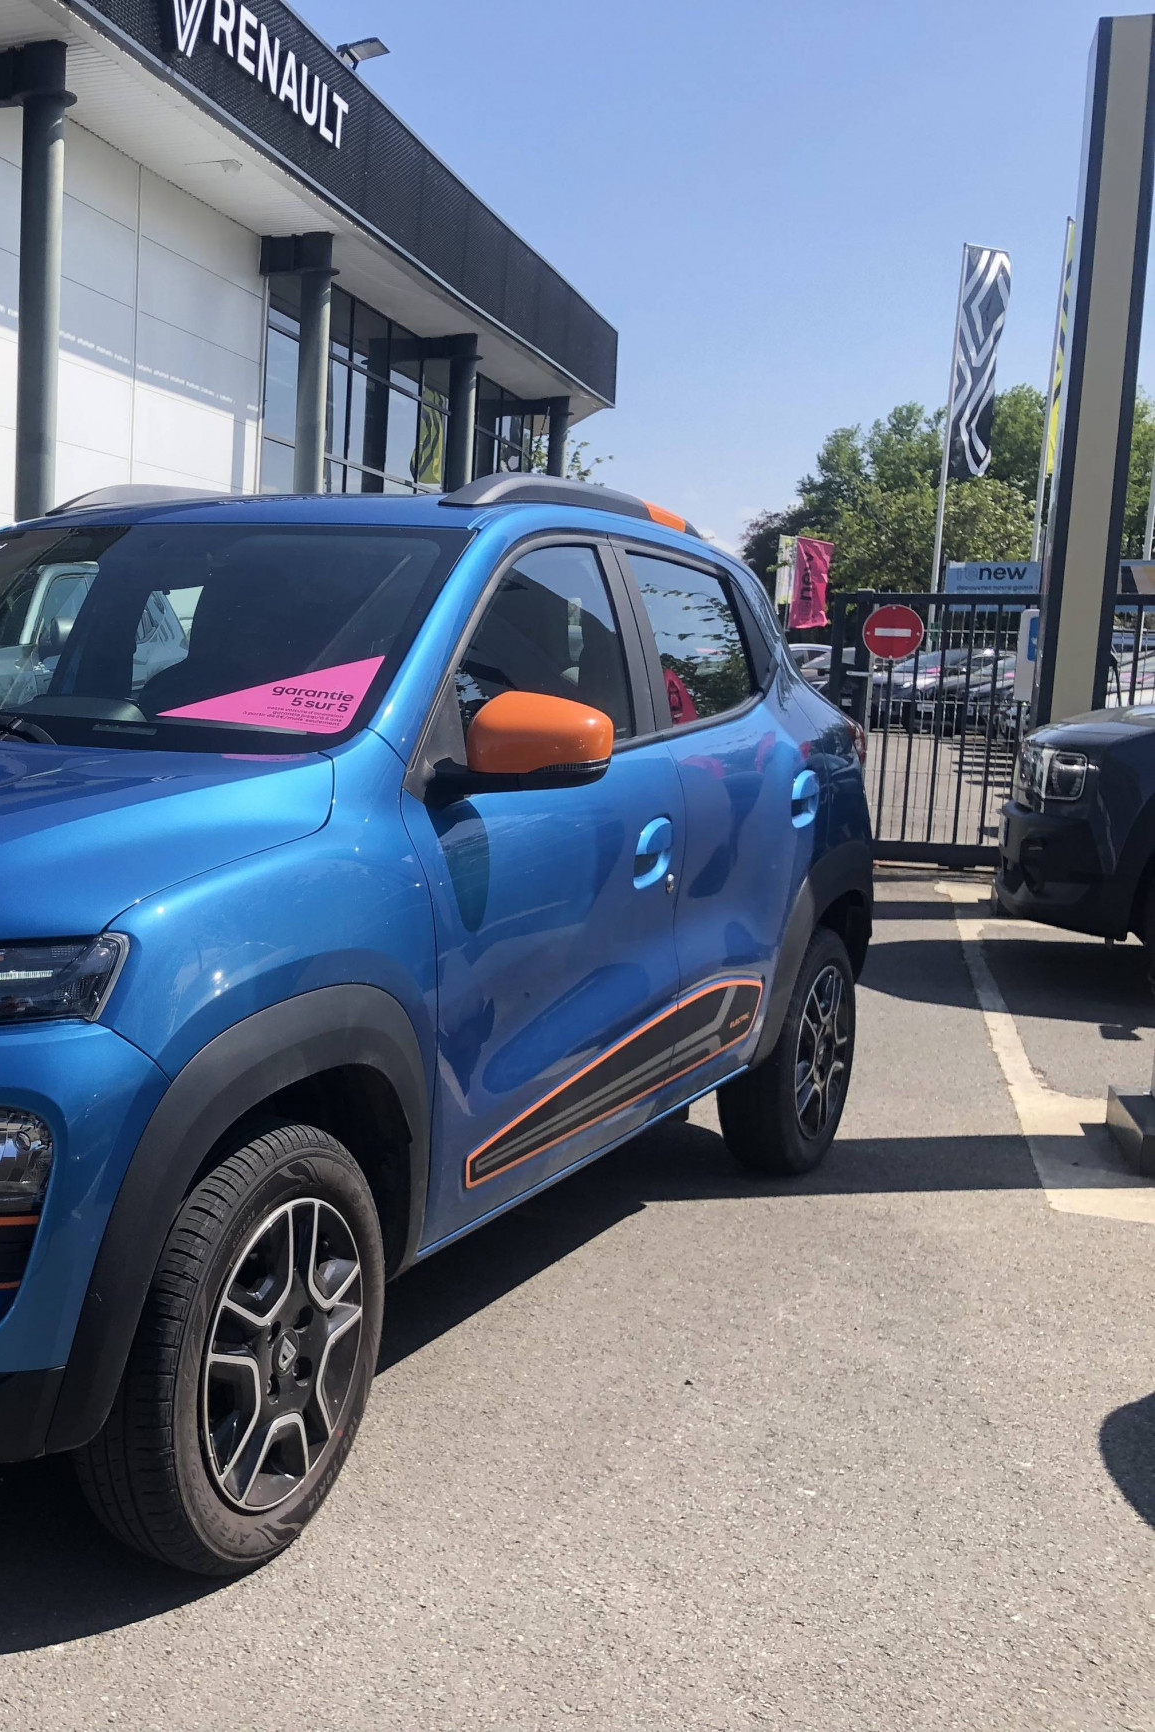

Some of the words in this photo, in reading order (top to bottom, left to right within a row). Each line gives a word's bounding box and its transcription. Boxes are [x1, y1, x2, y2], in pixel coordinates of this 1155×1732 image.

[212, 0, 349, 150] RENAULT
[956, 566, 1028, 581] renew
[272, 686, 354, 702] garantie
[291, 697, 304, 706] 5
[304, 700, 336, 711] sur
[337, 703, 350, 713] 5
